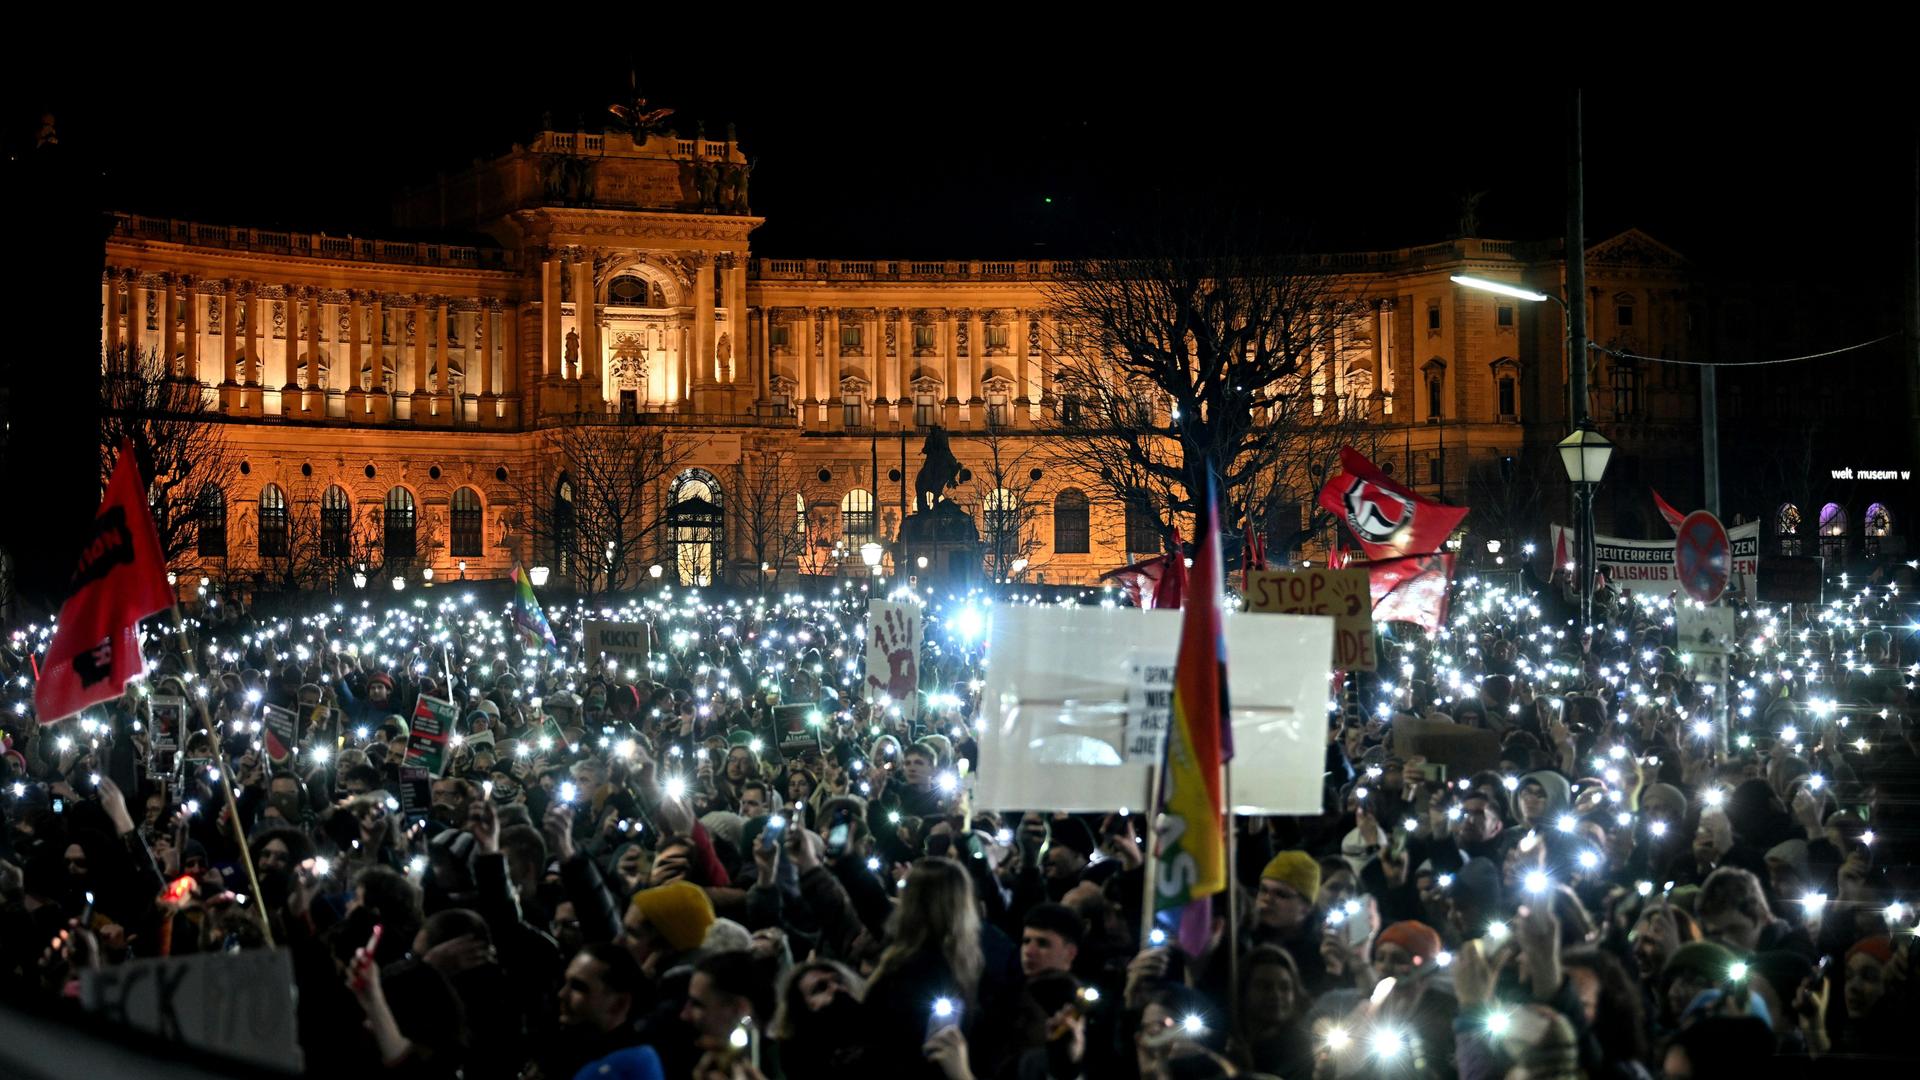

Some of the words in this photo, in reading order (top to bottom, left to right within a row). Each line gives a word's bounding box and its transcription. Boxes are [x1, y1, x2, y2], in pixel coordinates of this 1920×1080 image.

[1831, 466, 1854, 480] welt
[1857, 469, 1898, 480] museum
[1254, 572, 1326, 608] STOP
[1333, 628, 1374, 667] IDE
